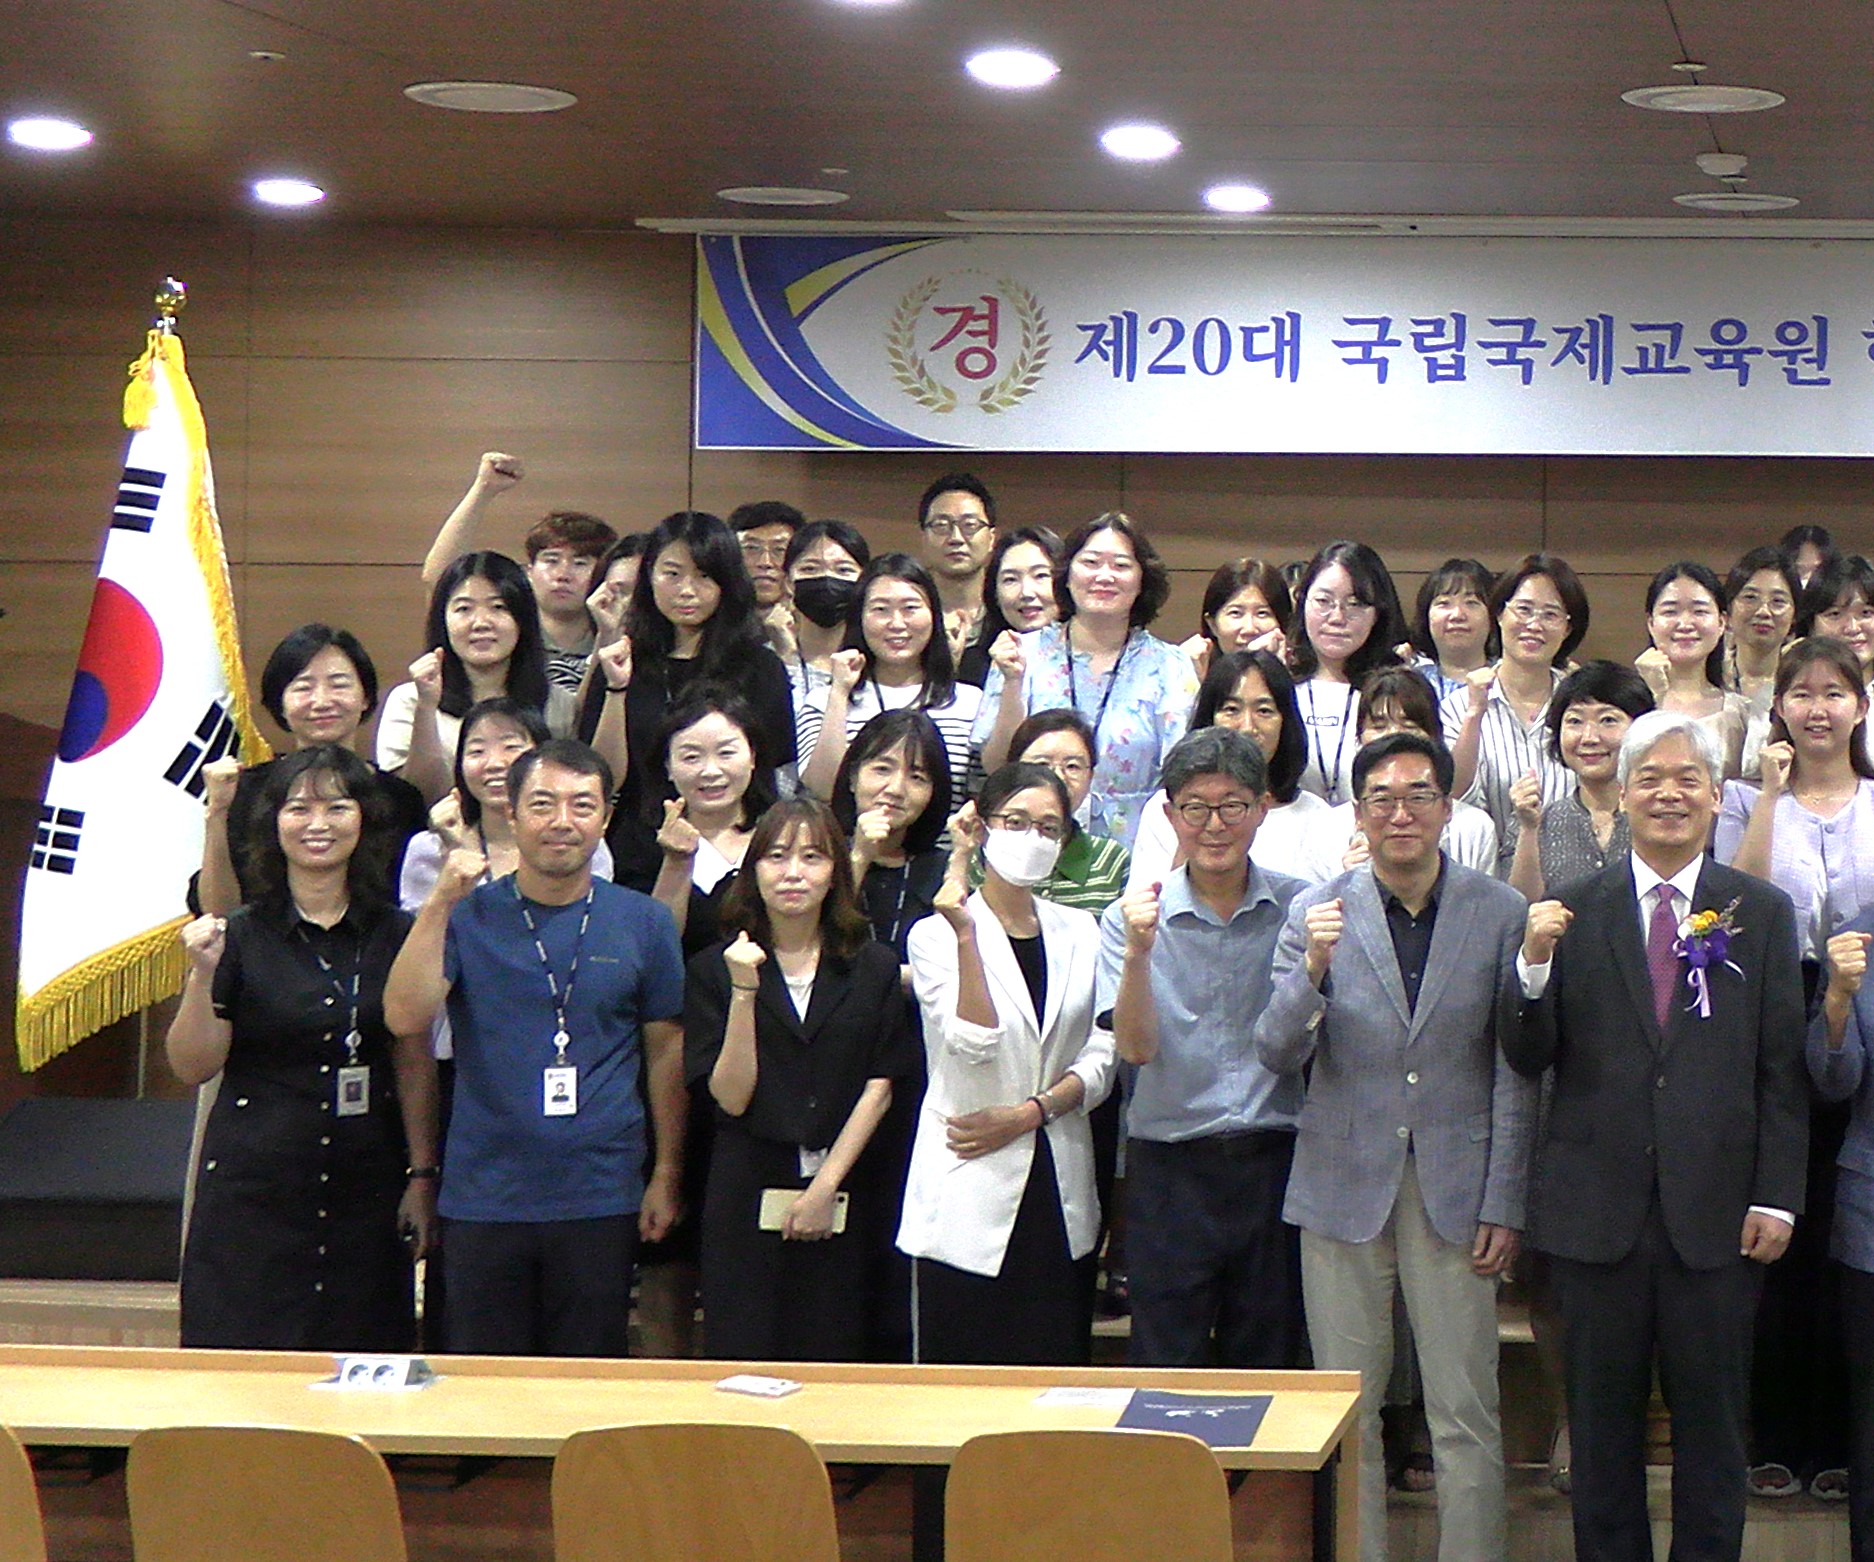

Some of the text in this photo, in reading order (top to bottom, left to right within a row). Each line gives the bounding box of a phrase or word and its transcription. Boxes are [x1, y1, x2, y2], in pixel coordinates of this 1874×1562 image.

[932, 295, 999, 380] 경
[1074, 310, 1303, 384] 제20대
[1331, 312, 1832, 387] 국립국제교육원
